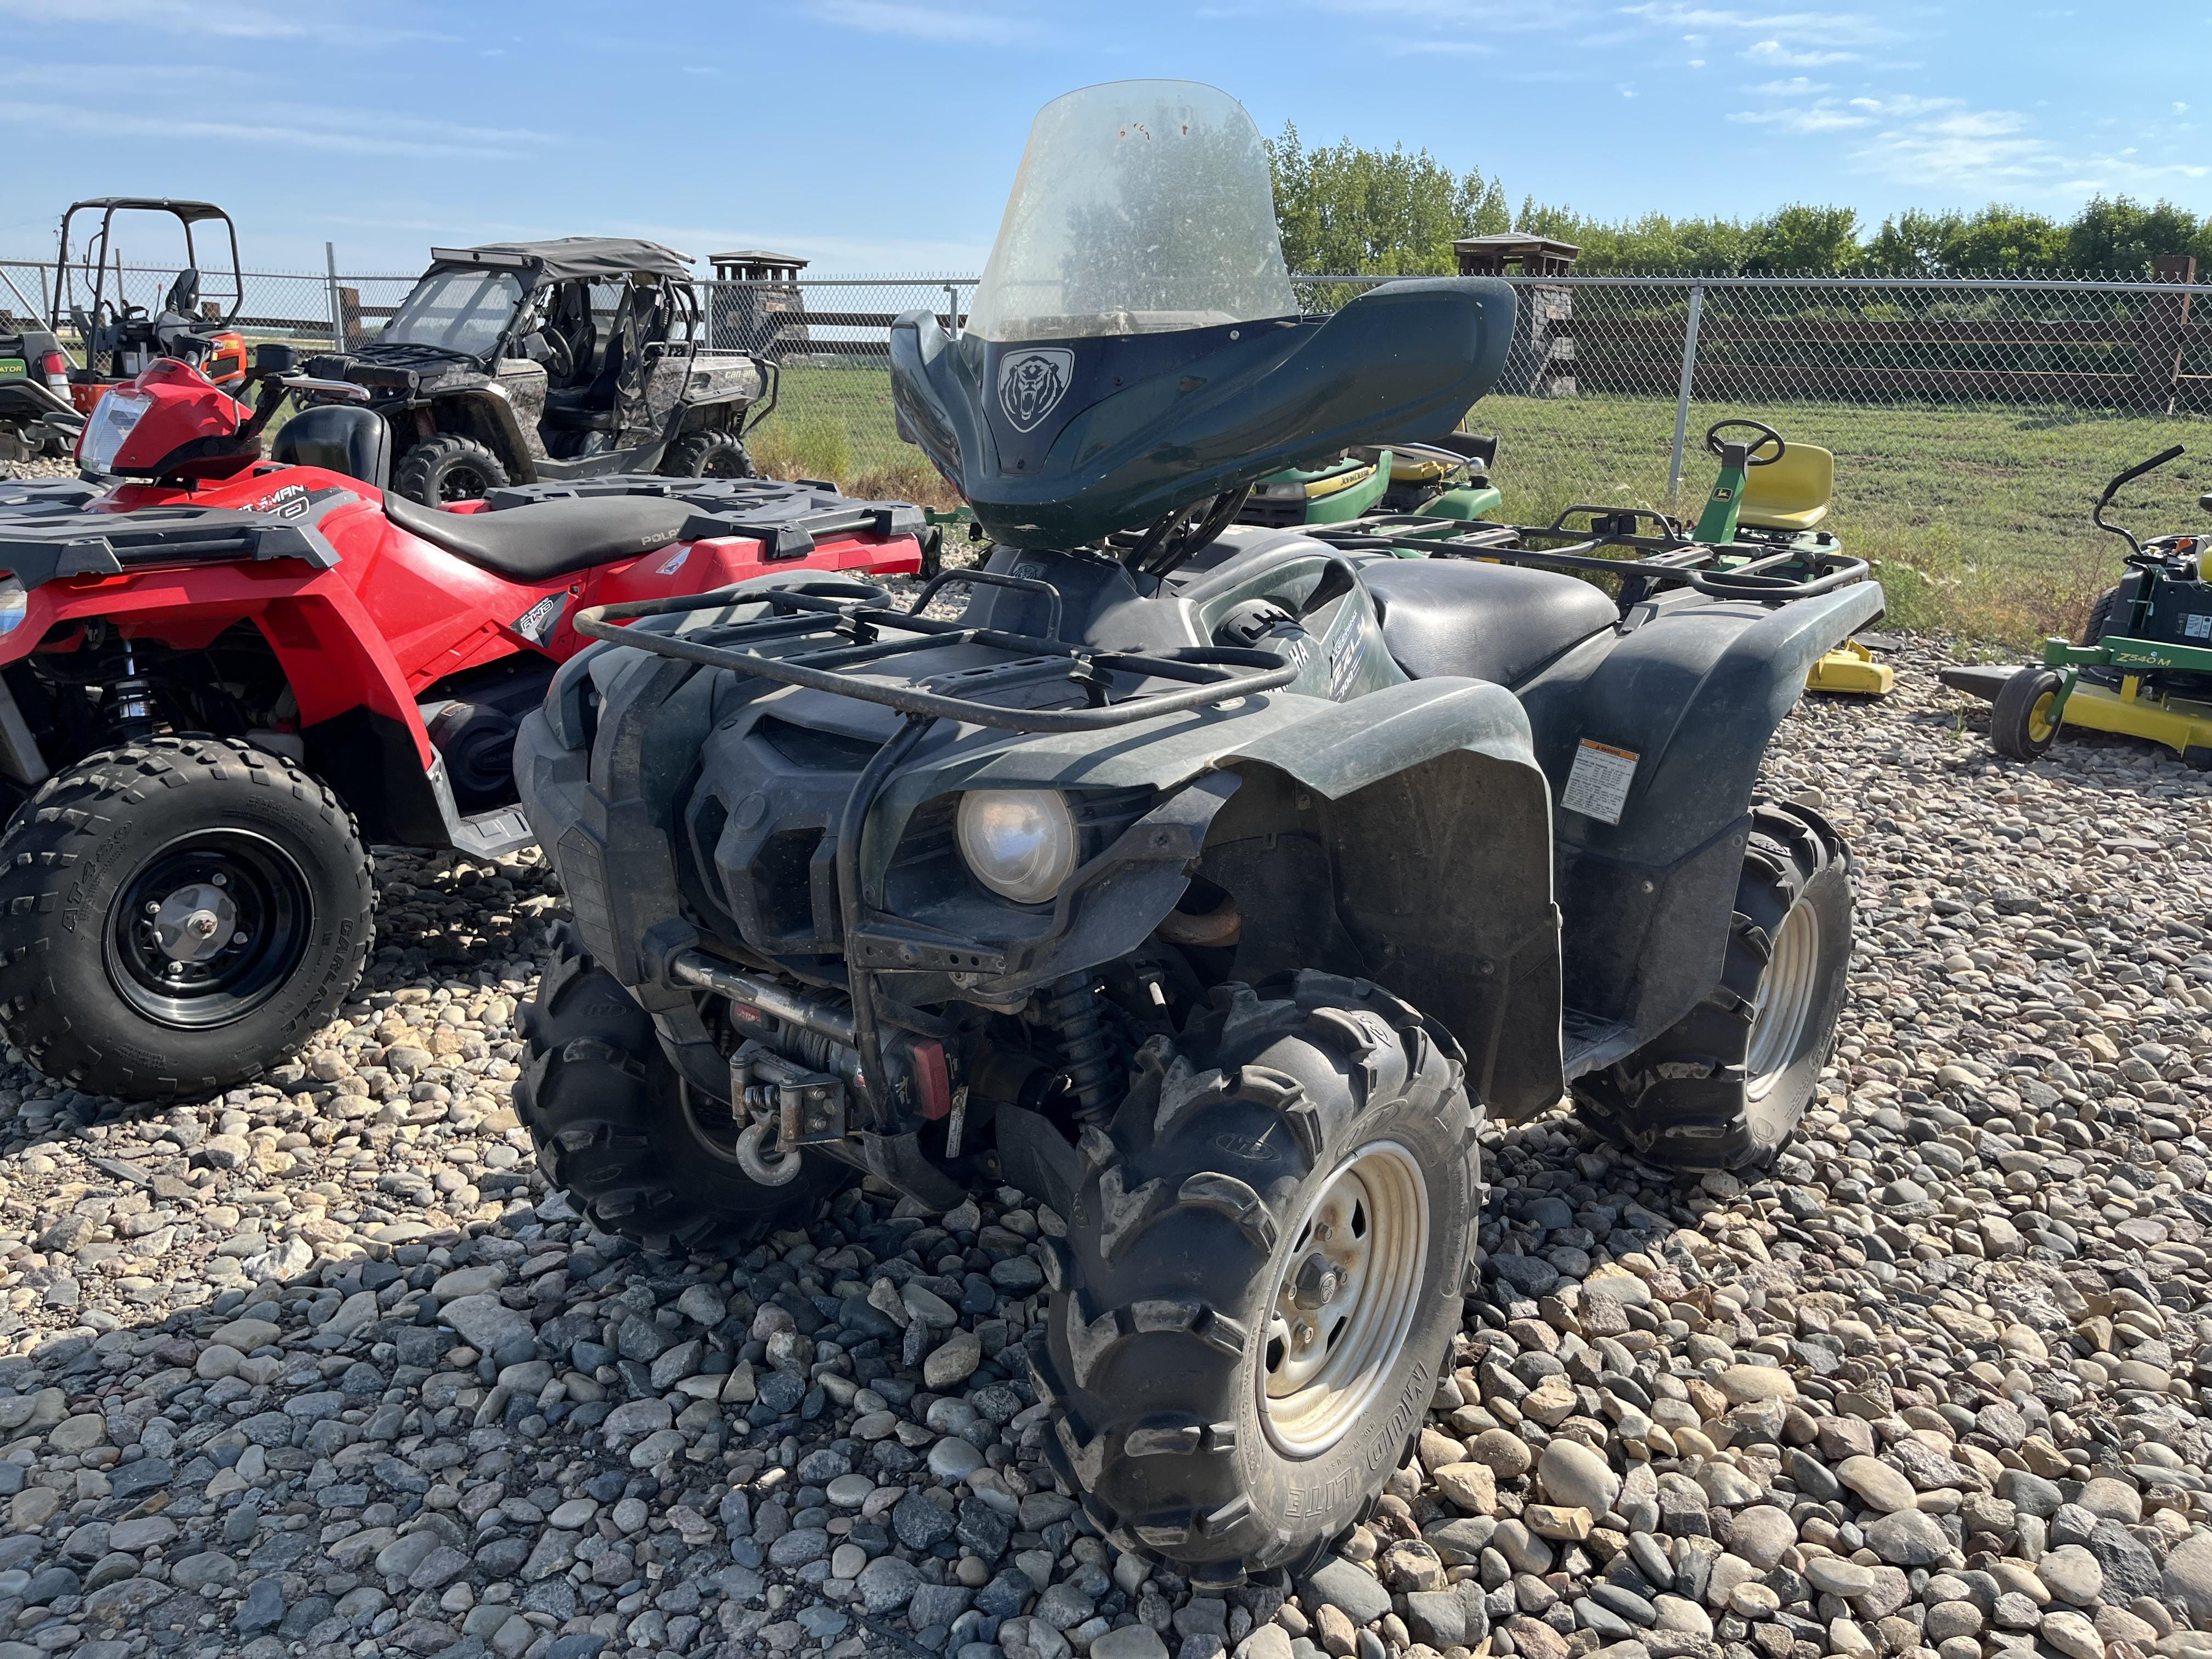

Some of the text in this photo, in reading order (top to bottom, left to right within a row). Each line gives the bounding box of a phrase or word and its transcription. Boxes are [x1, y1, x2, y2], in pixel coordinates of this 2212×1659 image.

[725, 369, 755, 379] can-am
[641, 528, 680, 546] POLA
[521, 600, 554, 631] AWD
[280, 919, 354, 1039] CARLISLE
[1361, 1419, 1376, 1440] MADE
[1285, 1361, 1430, 1518] MUD LITE
[1353, 1440, 1361, 1450] IN
[1342, 1450, 1352, 1462] THE
